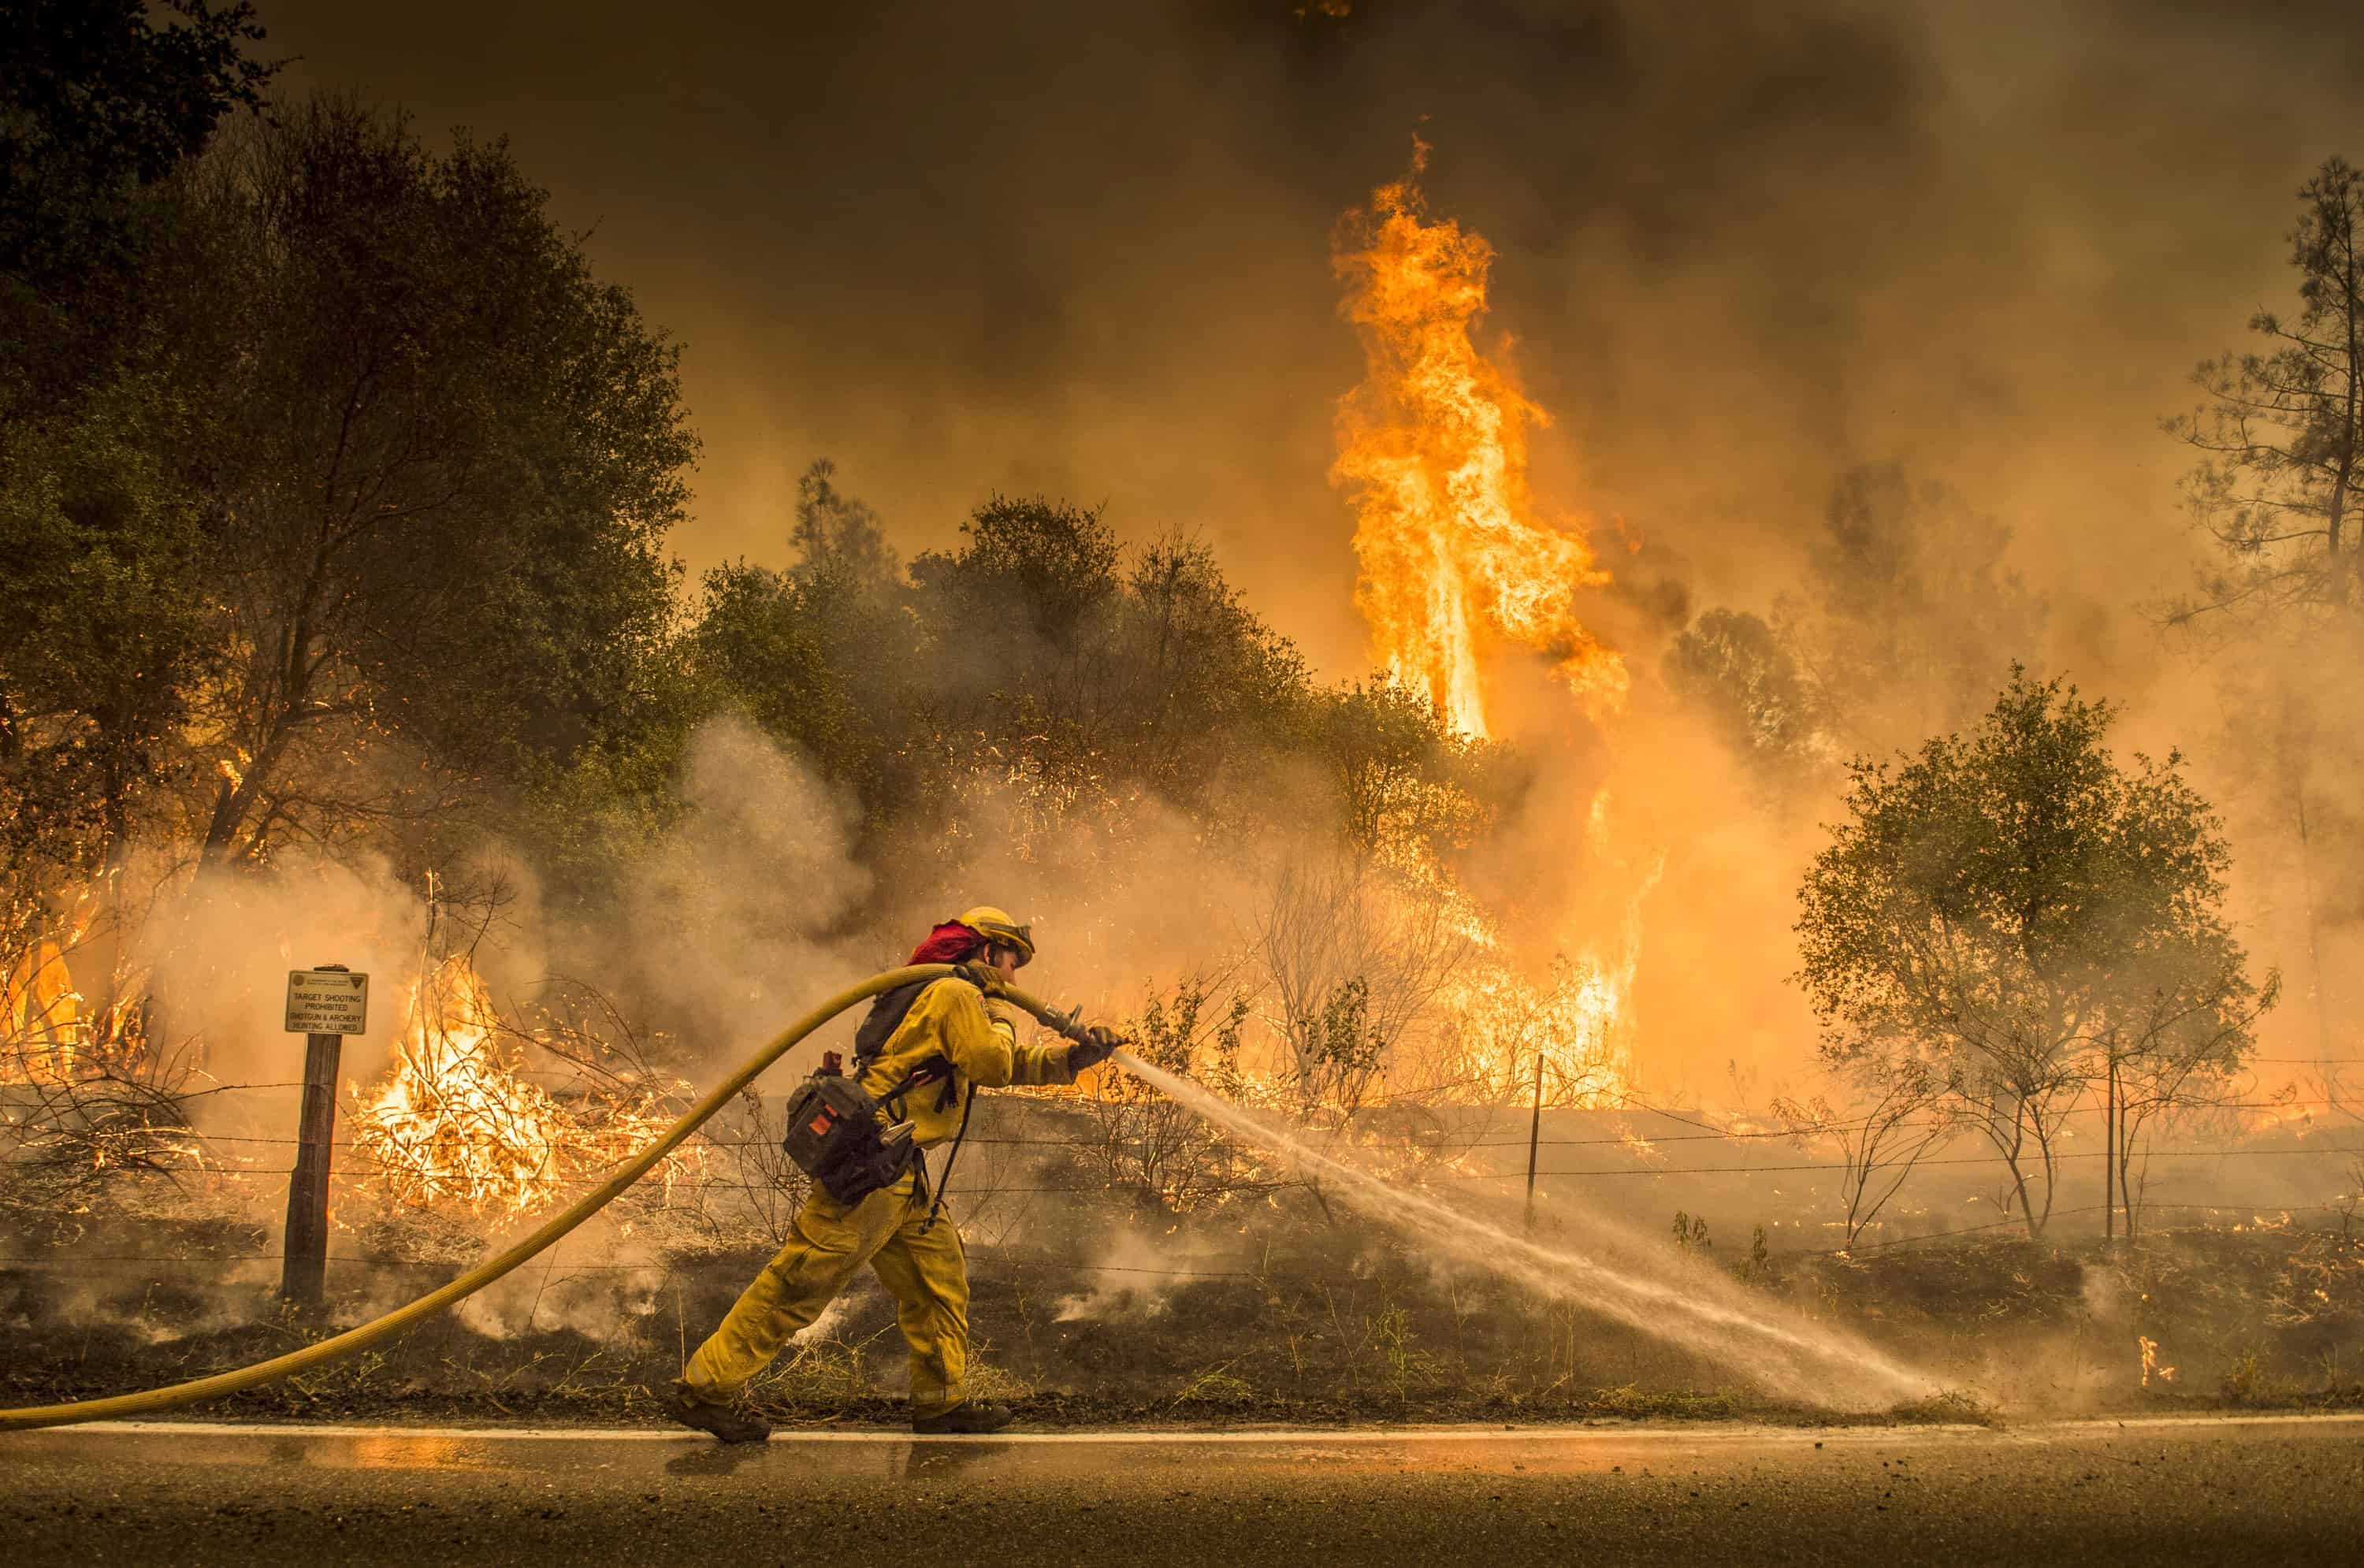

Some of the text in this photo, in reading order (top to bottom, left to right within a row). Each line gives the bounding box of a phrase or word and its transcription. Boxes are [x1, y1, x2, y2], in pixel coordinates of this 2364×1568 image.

[294, 993, 361, 1003] TARGET SHOOTING
[305, 1002, 348, 1011] PROHIBITED
[290, 1013, 322, 1021] SHOTGUN
